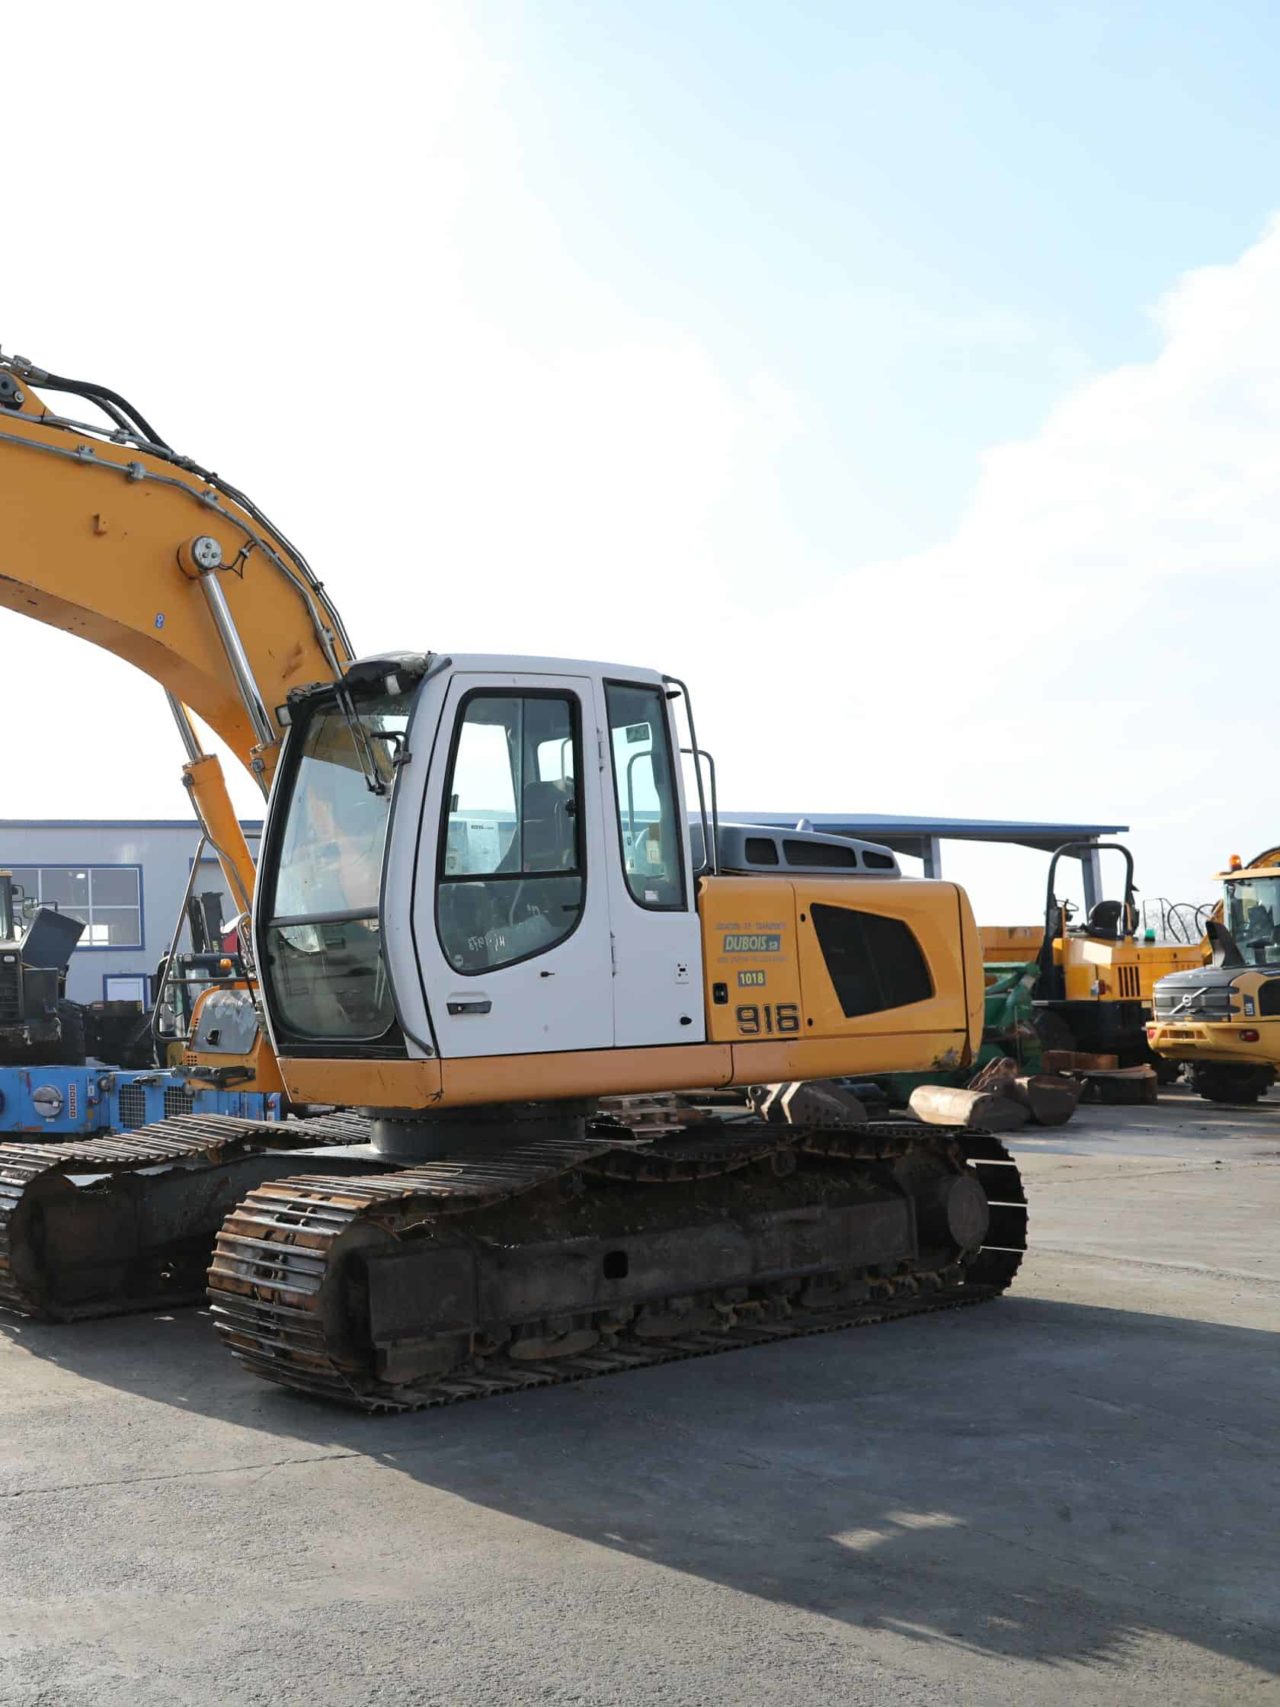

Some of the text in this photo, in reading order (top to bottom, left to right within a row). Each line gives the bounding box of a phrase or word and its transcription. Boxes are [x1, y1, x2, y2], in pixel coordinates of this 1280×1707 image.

[725, 935, 768, 951] DUBOIS
[739, 972, 764, 985] 1018
[736, 1003, 800, 1035] 916
